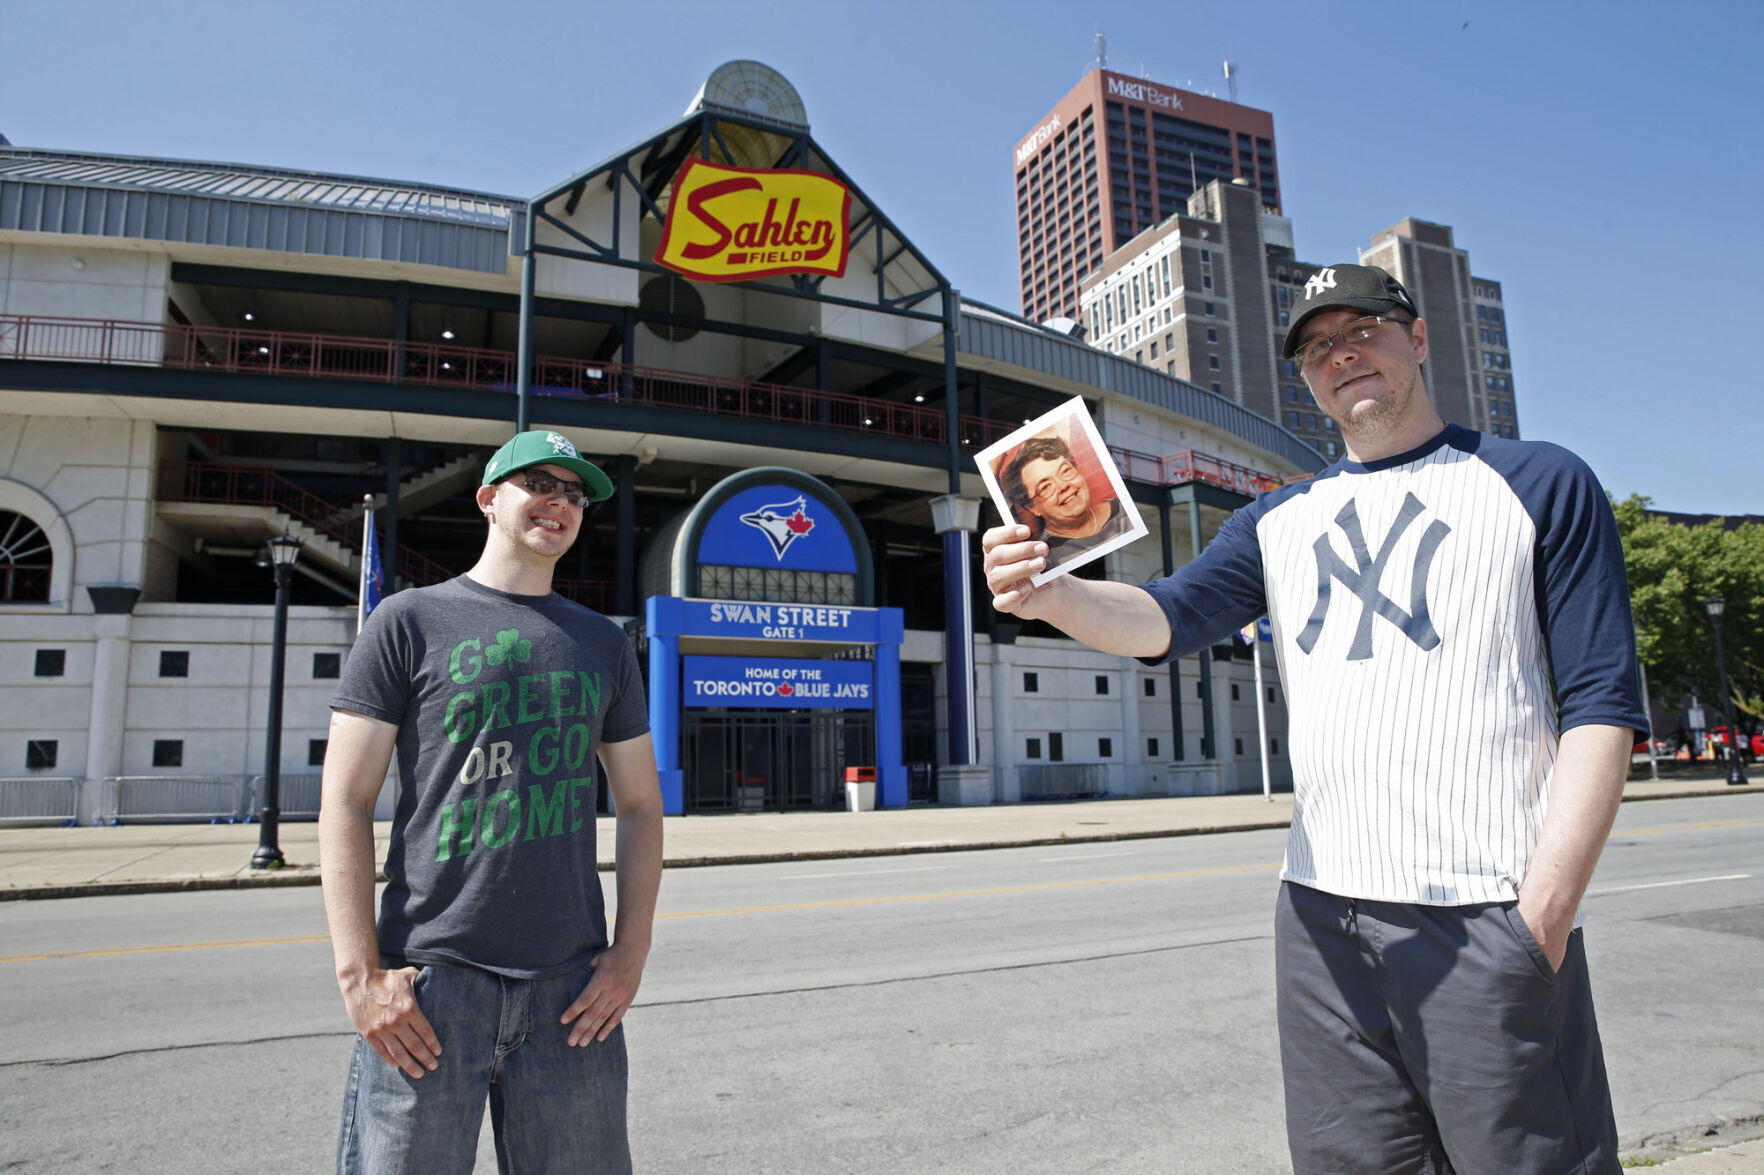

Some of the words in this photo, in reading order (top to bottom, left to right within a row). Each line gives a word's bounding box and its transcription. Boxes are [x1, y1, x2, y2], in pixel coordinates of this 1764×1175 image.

[681, 177, 835, 261] Sahlen
[749, 250, 803, 263] FIELD
[710, 603, 771, 625] SWAN
[777, 606, 851, 628] STREET
[762, 626, 795, 638] GATE
[797, 627, 804, 639] 1
[745, 668, 779, 679] HOME
[782, 669, 797, 680] OF
[800, 670, 821, 681] THE
[694, 680, 776, 697] TORONTO
[795, 683, 830, 698] BLUE
[833, 684, 868, 699] JAYS
[444, 670, 601, 743] GREEN
[460, 741, 513, 785] OR
[528, 723, 590, 775] GO
[435, 777, 592, 862] HOME
